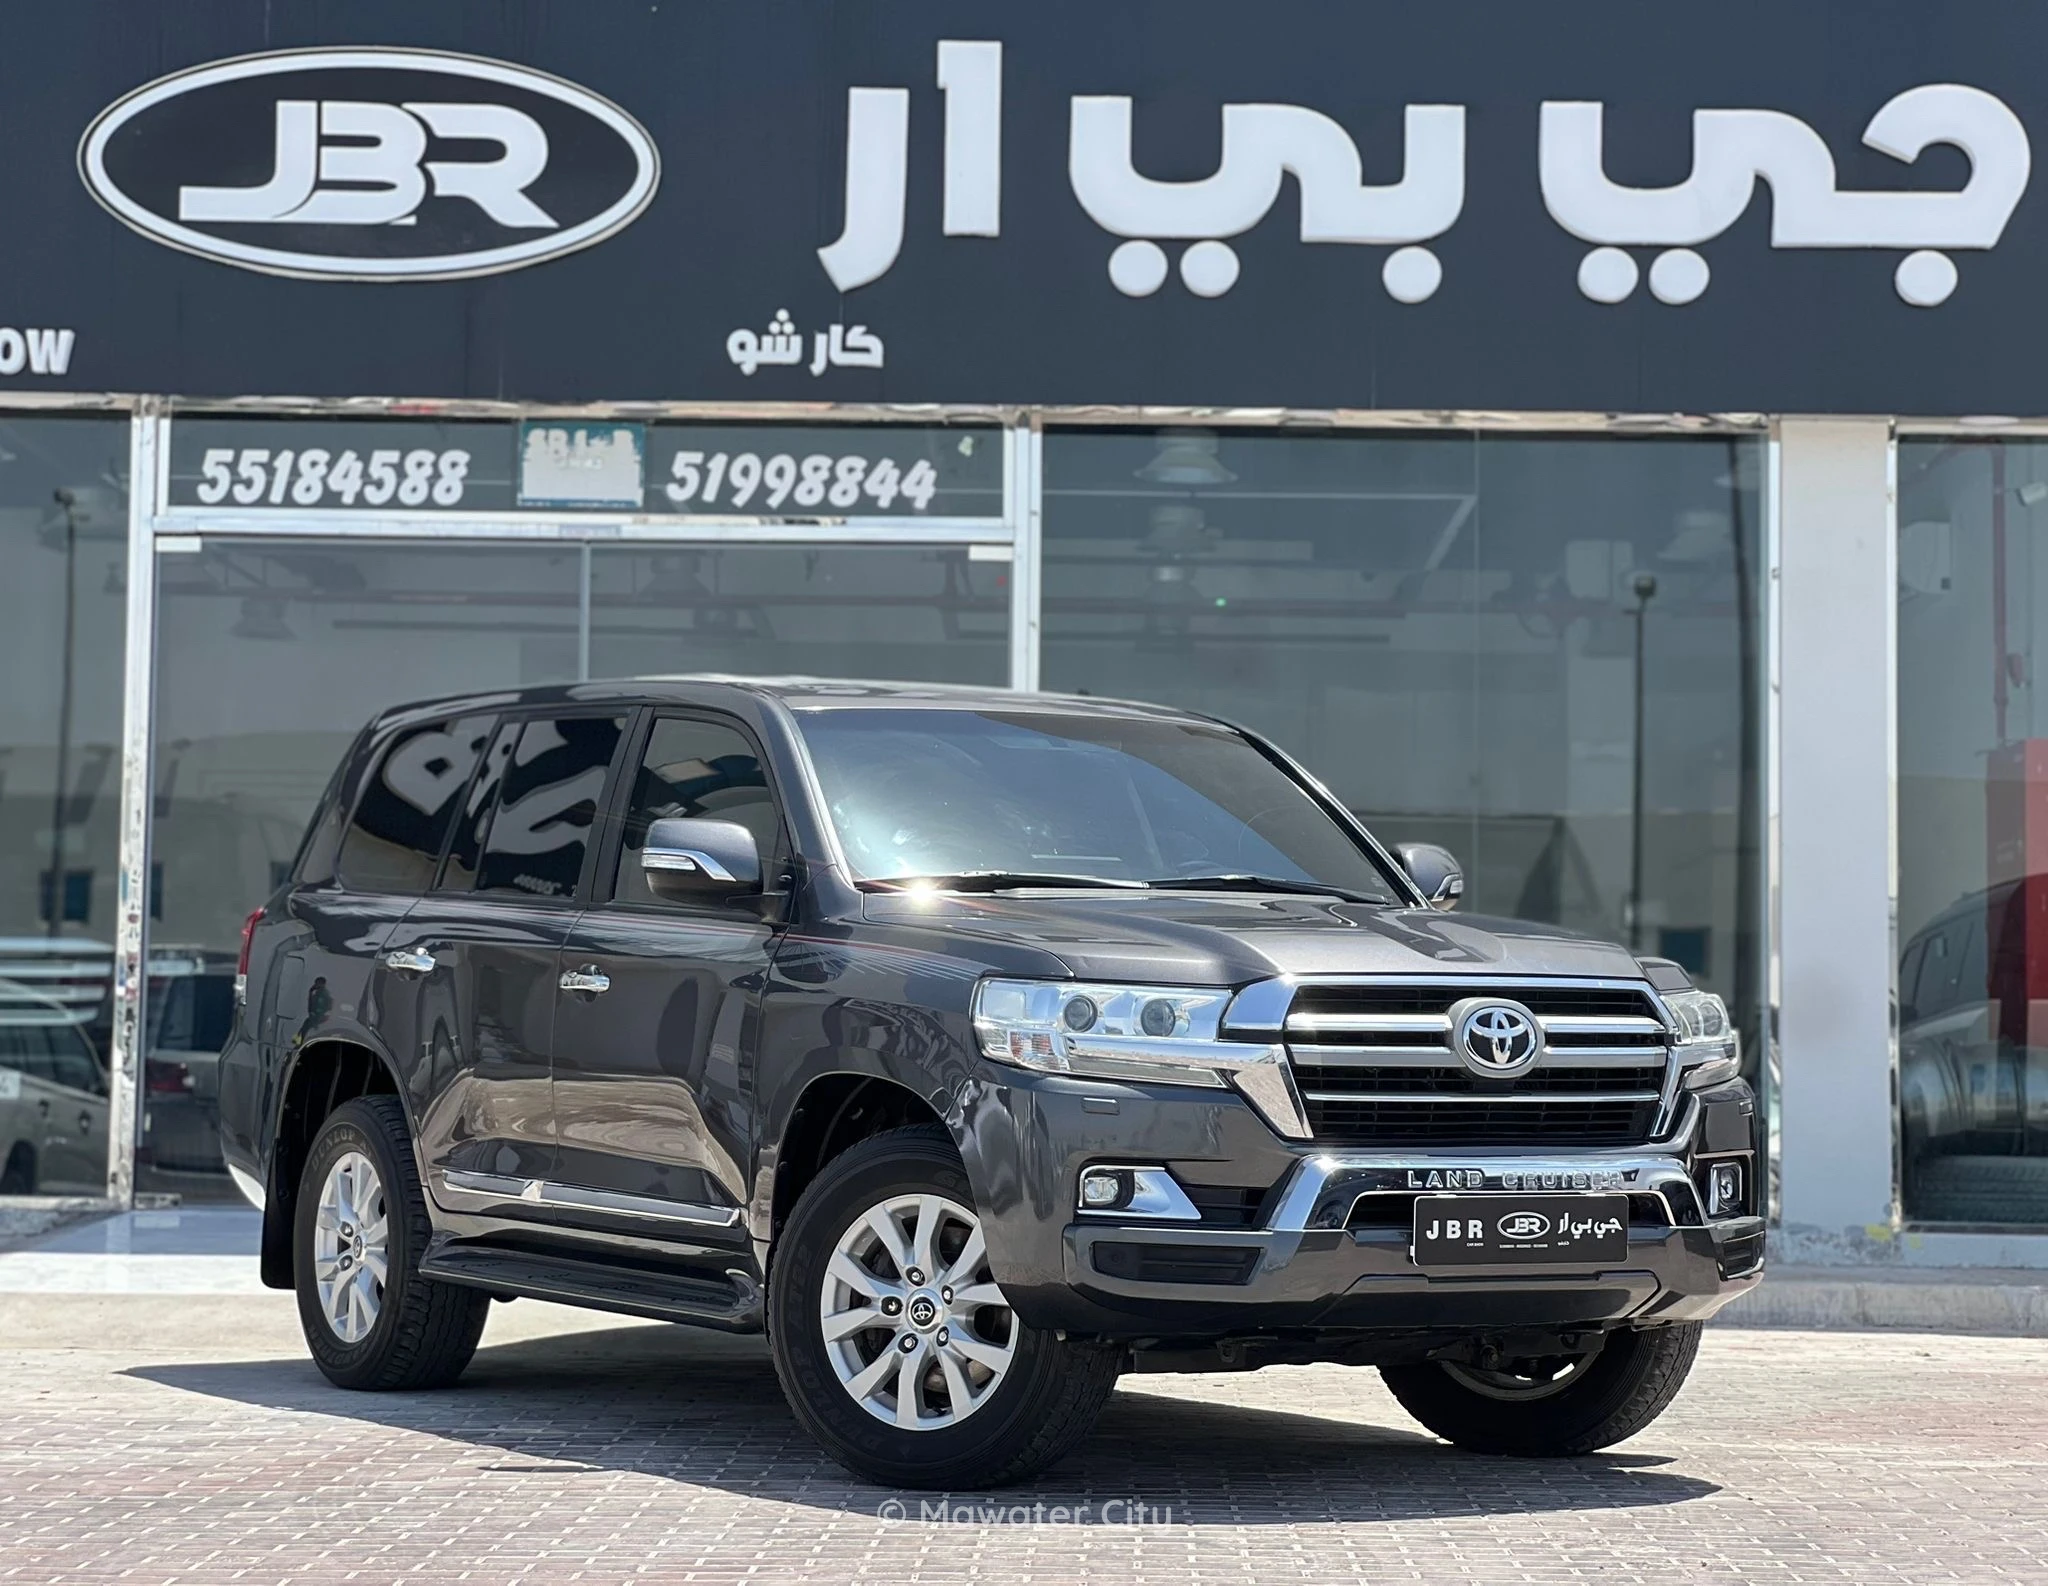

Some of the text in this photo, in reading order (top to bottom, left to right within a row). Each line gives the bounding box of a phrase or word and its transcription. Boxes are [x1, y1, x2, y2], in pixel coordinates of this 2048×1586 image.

[179, 100, 559, 228] JBR
[817, 40, 2031, 306] جي بي ار
[726, 308, 884, 377] كار شو
[197, 448, 470, 505] 55184588
[666, 451, 937, 509] 51998844
[1407, 1170, 1484, 1188] LAND
[1506, 1217, 1541, 1234] JBR
